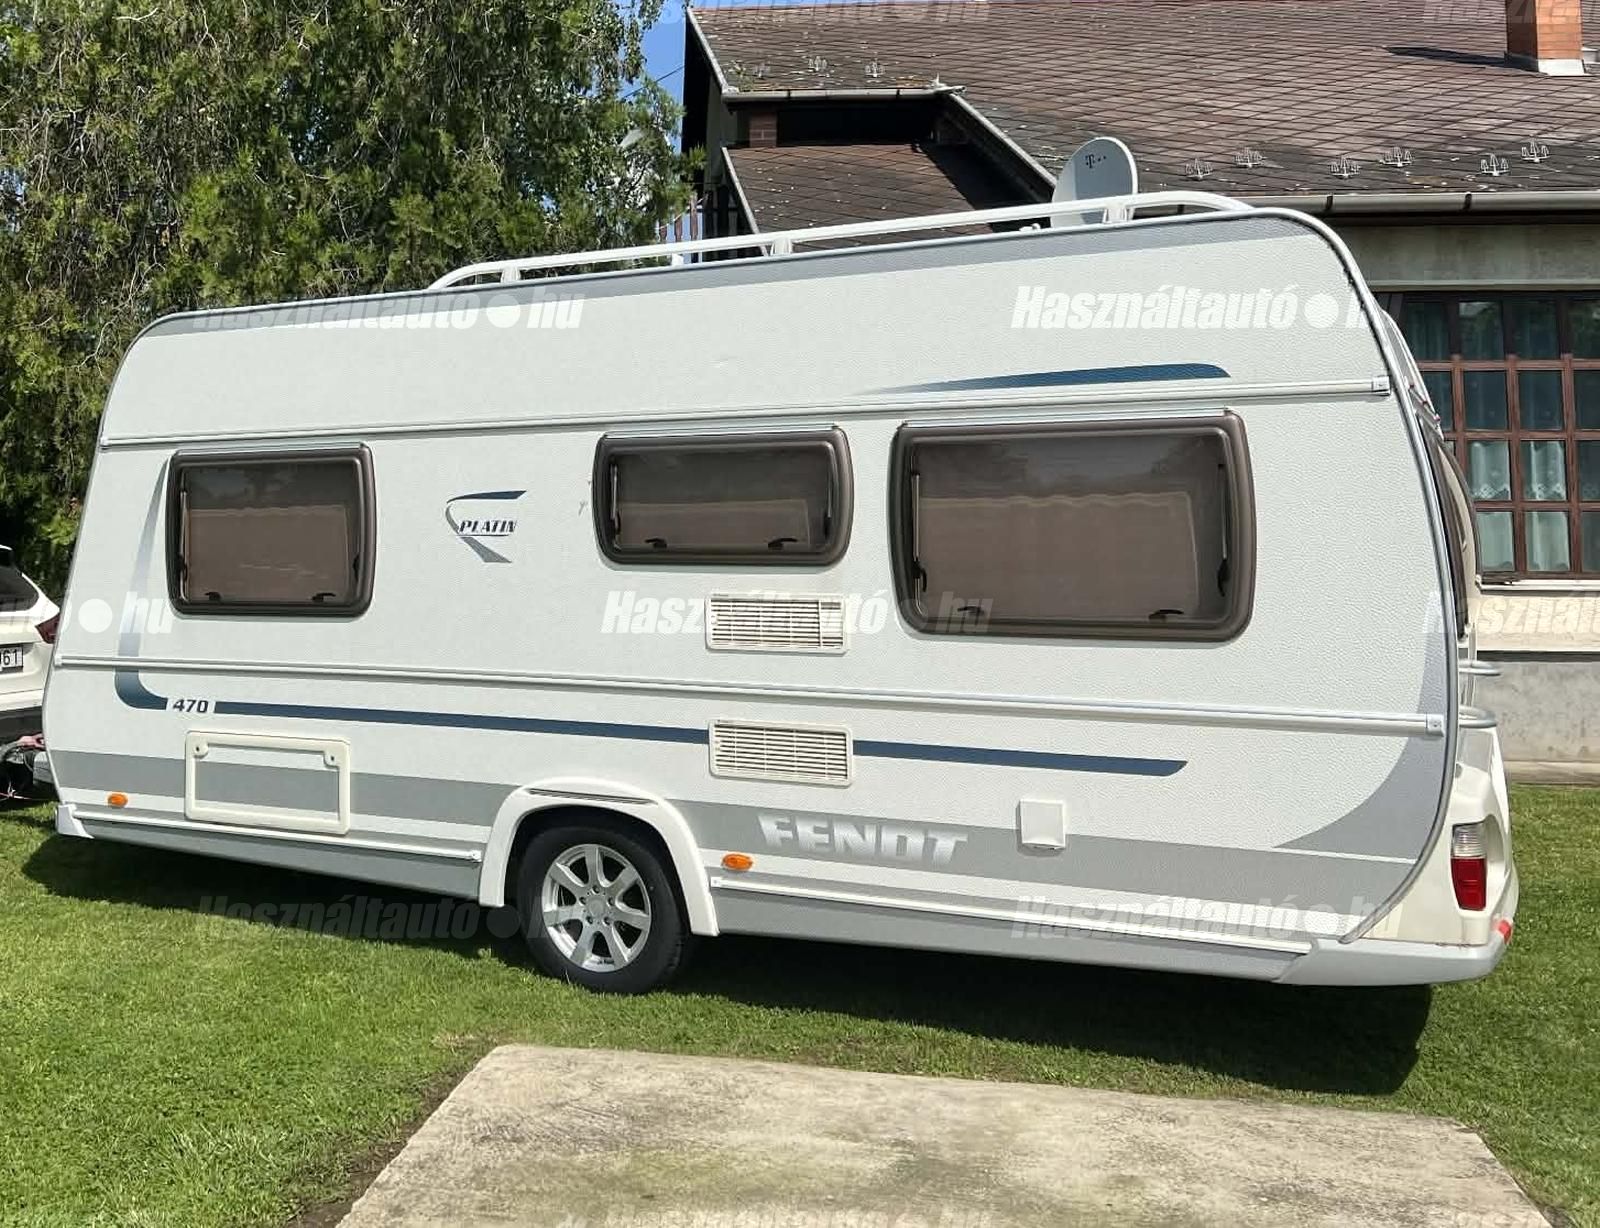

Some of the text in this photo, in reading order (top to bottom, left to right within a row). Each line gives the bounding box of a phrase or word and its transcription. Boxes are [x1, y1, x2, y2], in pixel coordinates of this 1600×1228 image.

[459, 519, 517, 533] PLATIN
[0, 649, 18, 666] 61
[172, 699, 209, 713] 470
[757, 813, 968, 867] FENDT
